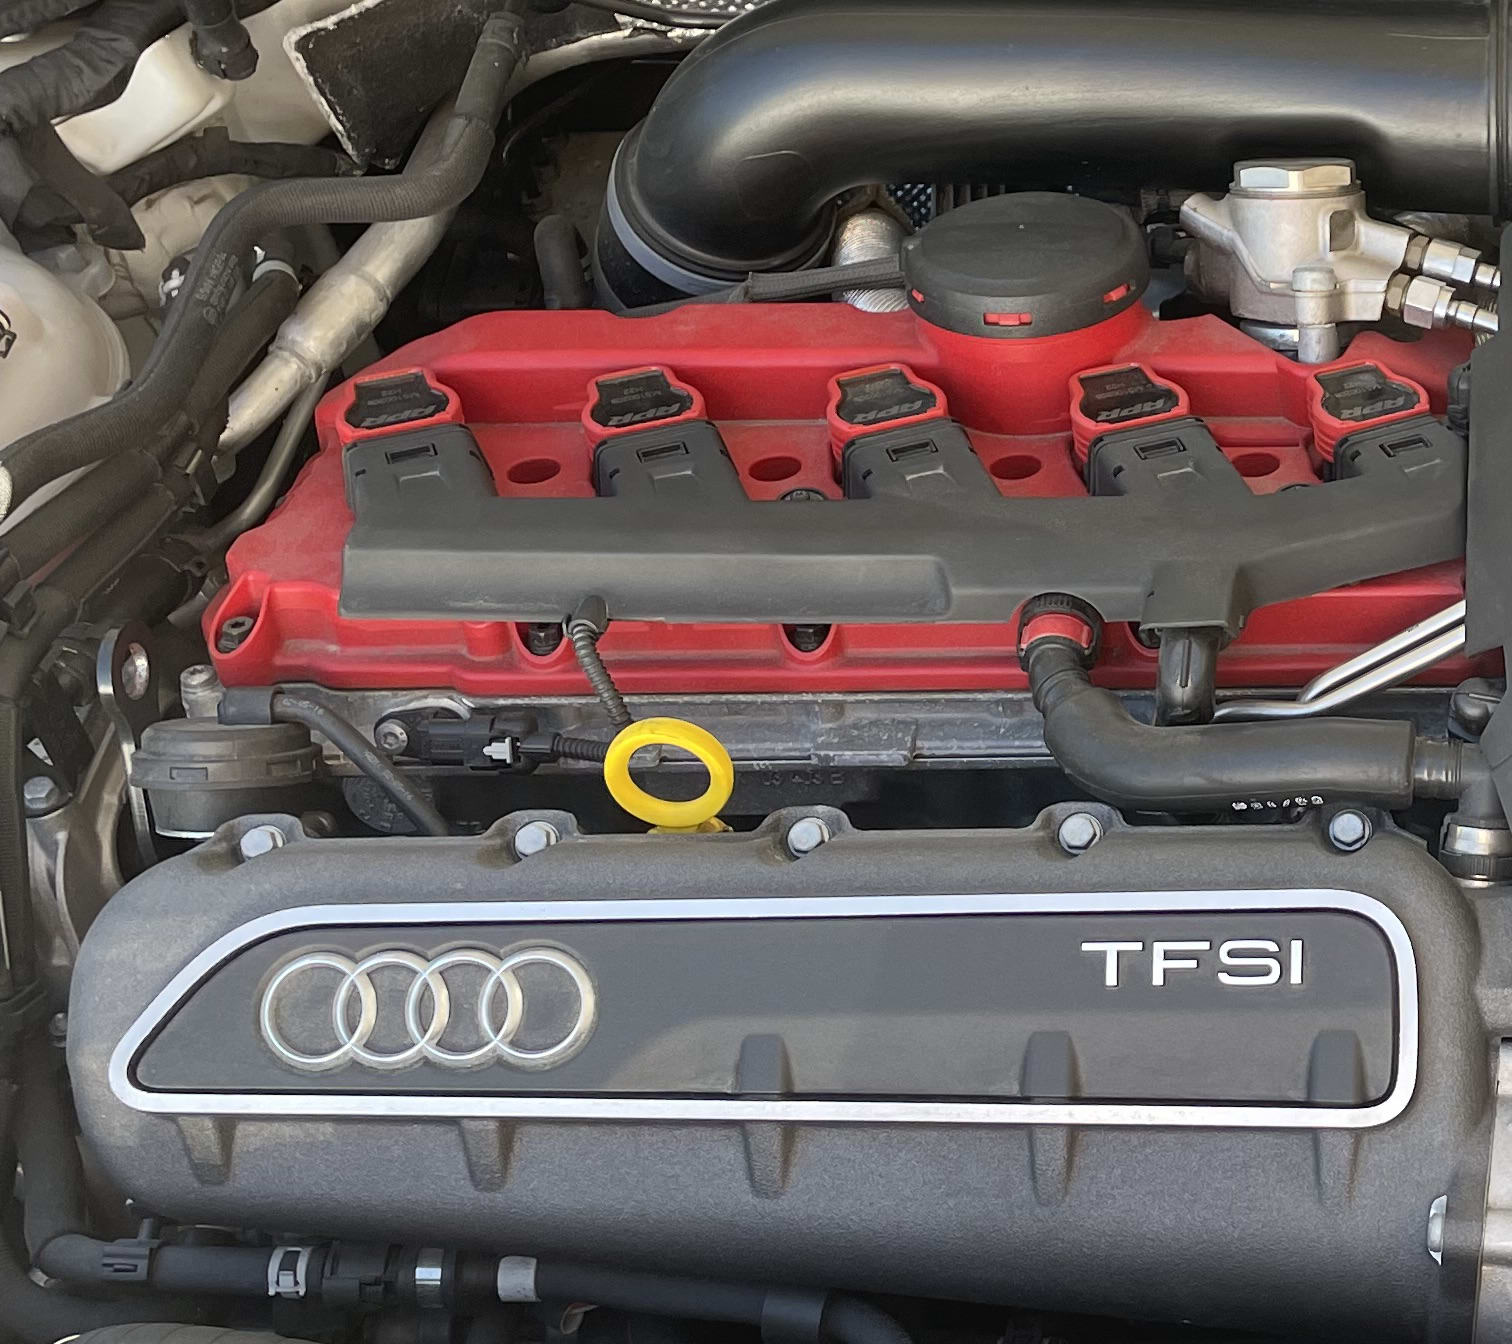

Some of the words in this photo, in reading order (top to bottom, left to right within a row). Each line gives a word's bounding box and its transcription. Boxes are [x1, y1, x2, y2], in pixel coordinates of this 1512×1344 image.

[360, 405, 436, 426] APR
[607, 403, 680, 425] APR
[853, 400, 923, 423] APR
[1097, 399, 1165, 422] APR
[1340, 396, 1406, 419] APR
[1081, 940, 1303, 987] TFSI
